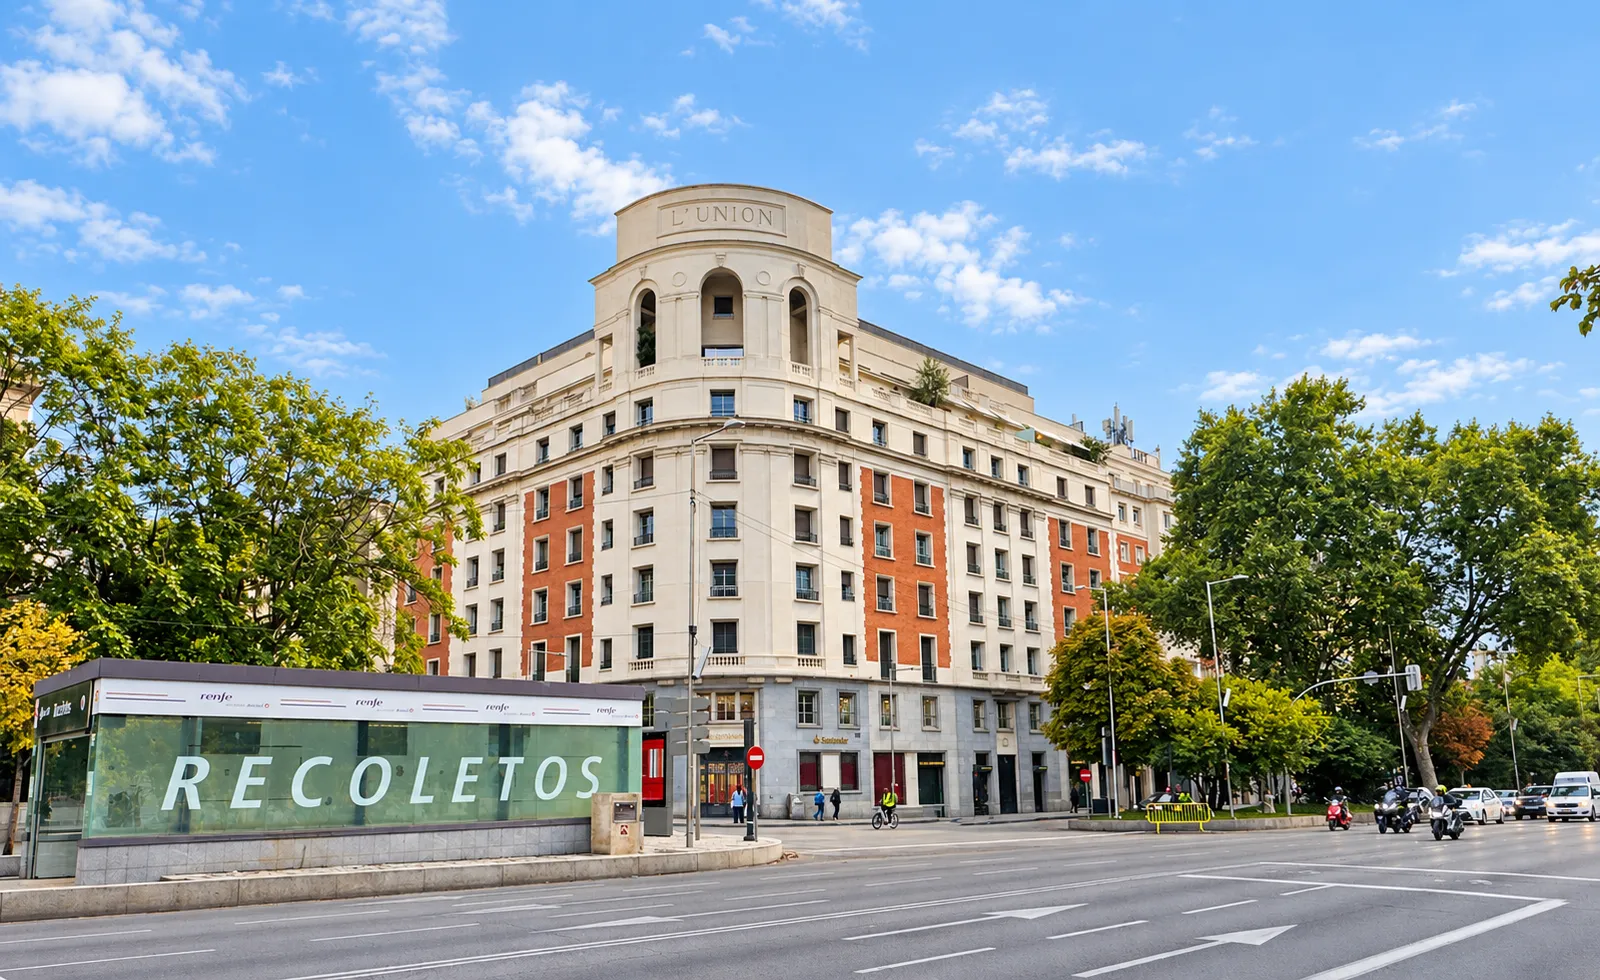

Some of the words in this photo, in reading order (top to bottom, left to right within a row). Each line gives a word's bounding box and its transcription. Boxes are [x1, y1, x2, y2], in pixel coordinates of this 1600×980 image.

[200, 691, 233, 703] renfe
[355, 698, 383, 708] renfe
[485, 703, 510, 713] renfe
[596, 707, 617, 715] renfe
[160, 755, 603, 811] RECOLETOS
